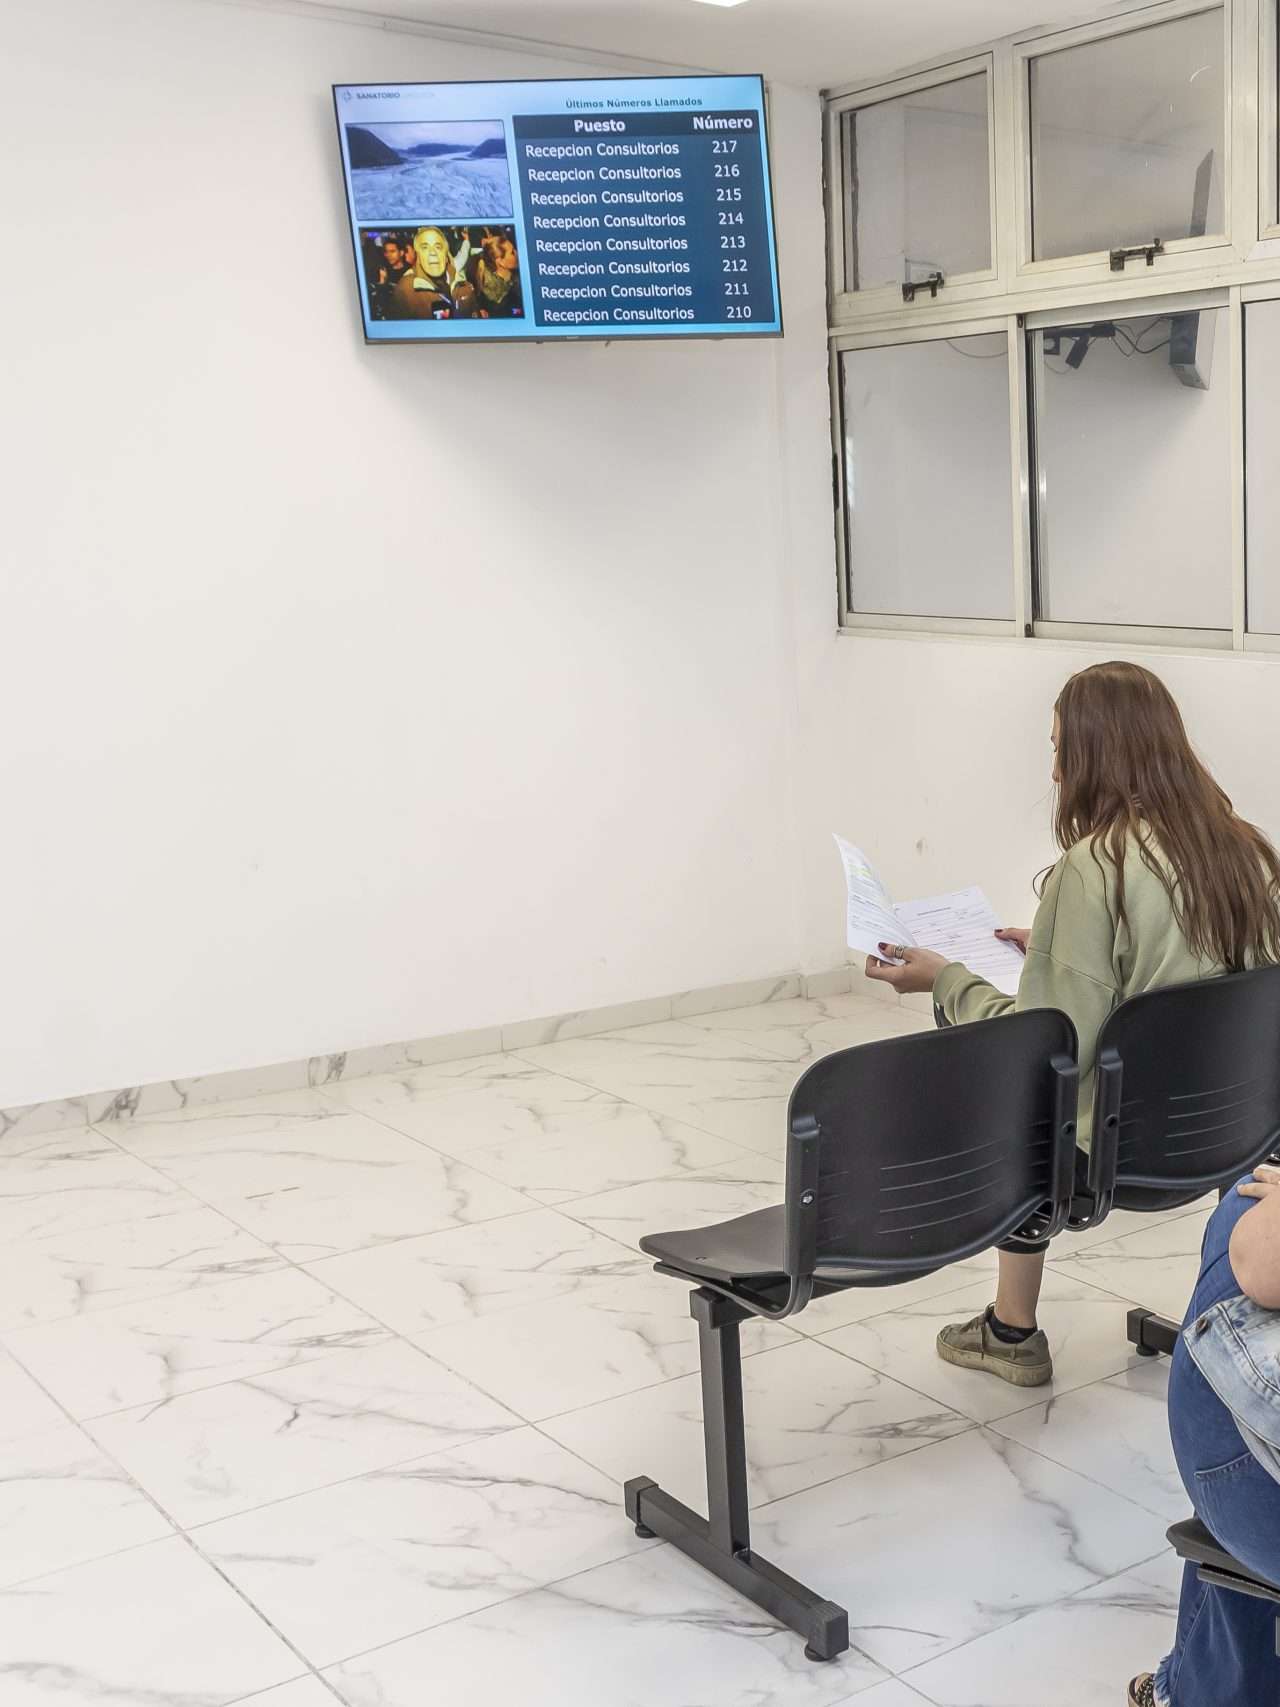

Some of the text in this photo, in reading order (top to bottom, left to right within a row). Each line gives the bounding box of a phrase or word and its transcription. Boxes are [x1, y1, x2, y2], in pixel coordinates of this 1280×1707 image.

[566, 98, 703, 108] Últimos Números Llamados
[574, 116, 753, 132] Puesto Número
[526, 141, 737, 158] Recepcion Consultorios 217
[528, 165, 740, 182] Recepcion Consultorios 216
[531, 189, 741, 206] Recepcion Consultorios 215
[533, 212, 744, 230] Recepcion Consultorios 214
[536, 236, 745, 253] Recepcion Consultorios 213
[539, 260, 748, 277] Recepcion Consultorios 212
[541, 283, 748, 300] Recepcion Consultorios 211
[544, 306, 751, 323] Recepcion Consultorios 210
